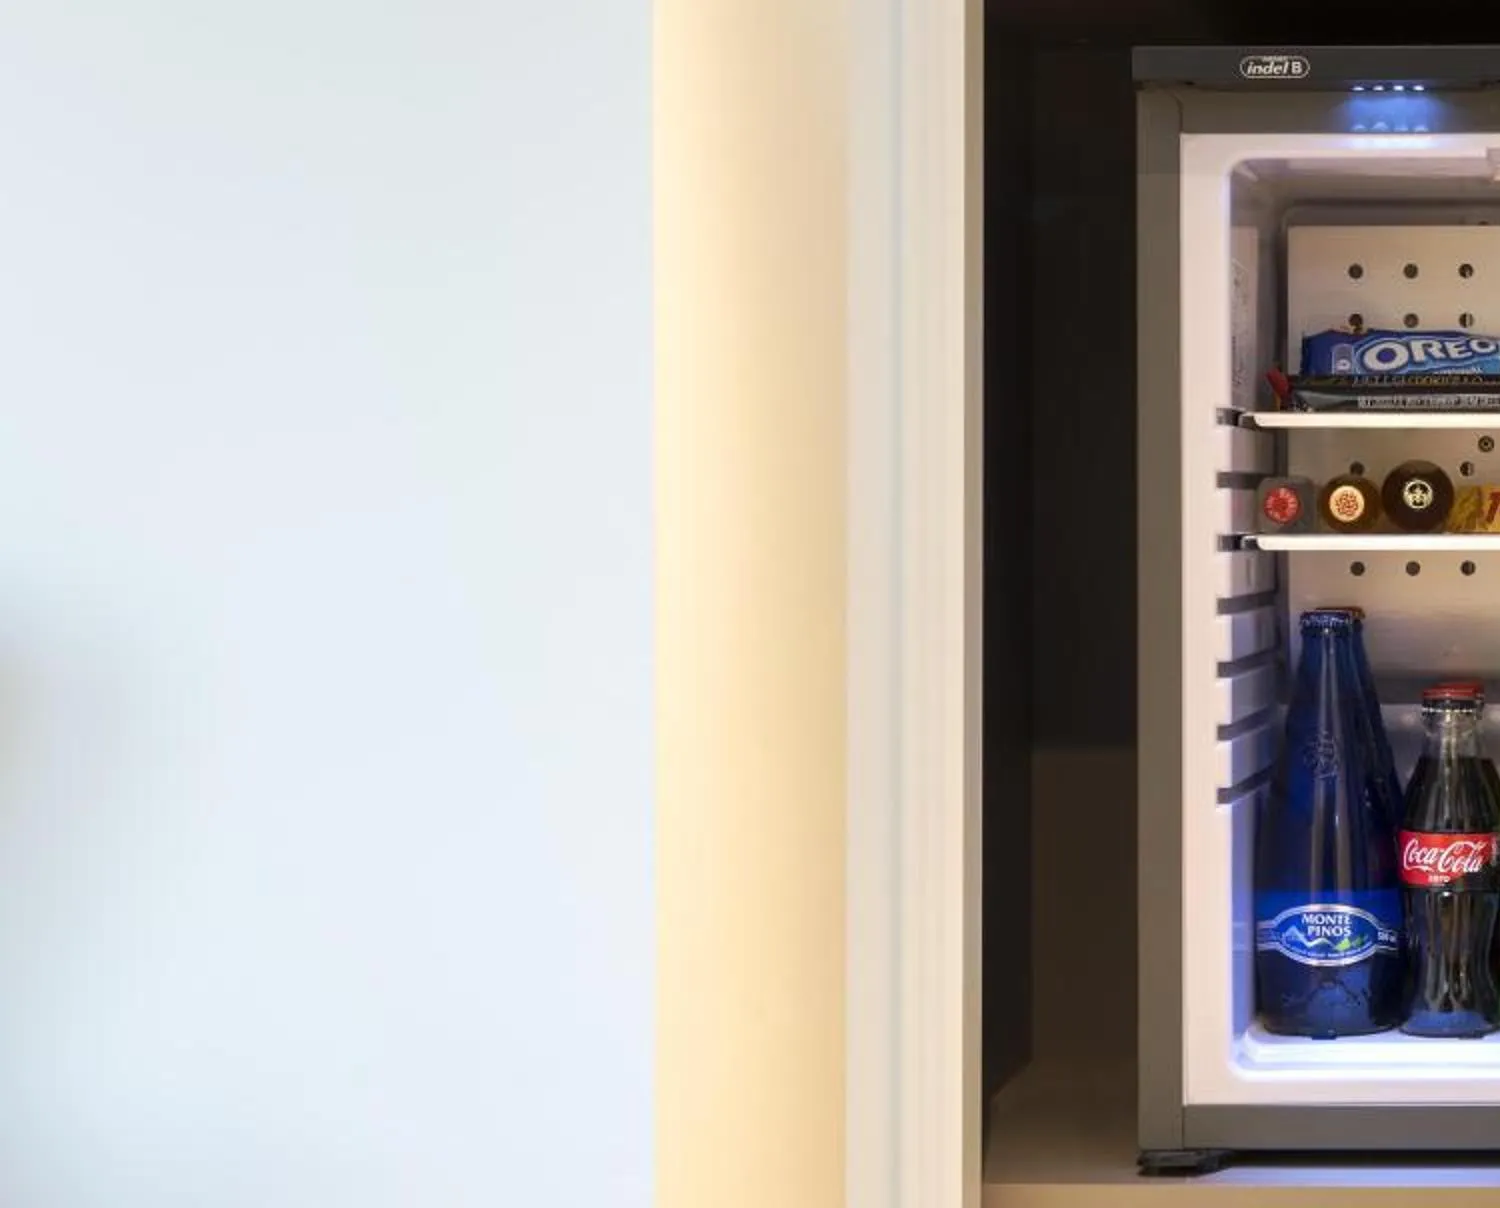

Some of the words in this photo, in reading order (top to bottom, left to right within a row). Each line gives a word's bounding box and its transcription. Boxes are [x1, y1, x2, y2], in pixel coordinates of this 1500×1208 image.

[1246, 61, 1289, 75] indel
[1291, 61, 1303, 75] B
[1363, 338, 1498, 371] OREO
[1403, 838, 1486, 873] Coca-Cola
[1301, 913, 1353, 925] MONTE
[1307, 925, 1353, 937] PINOS
